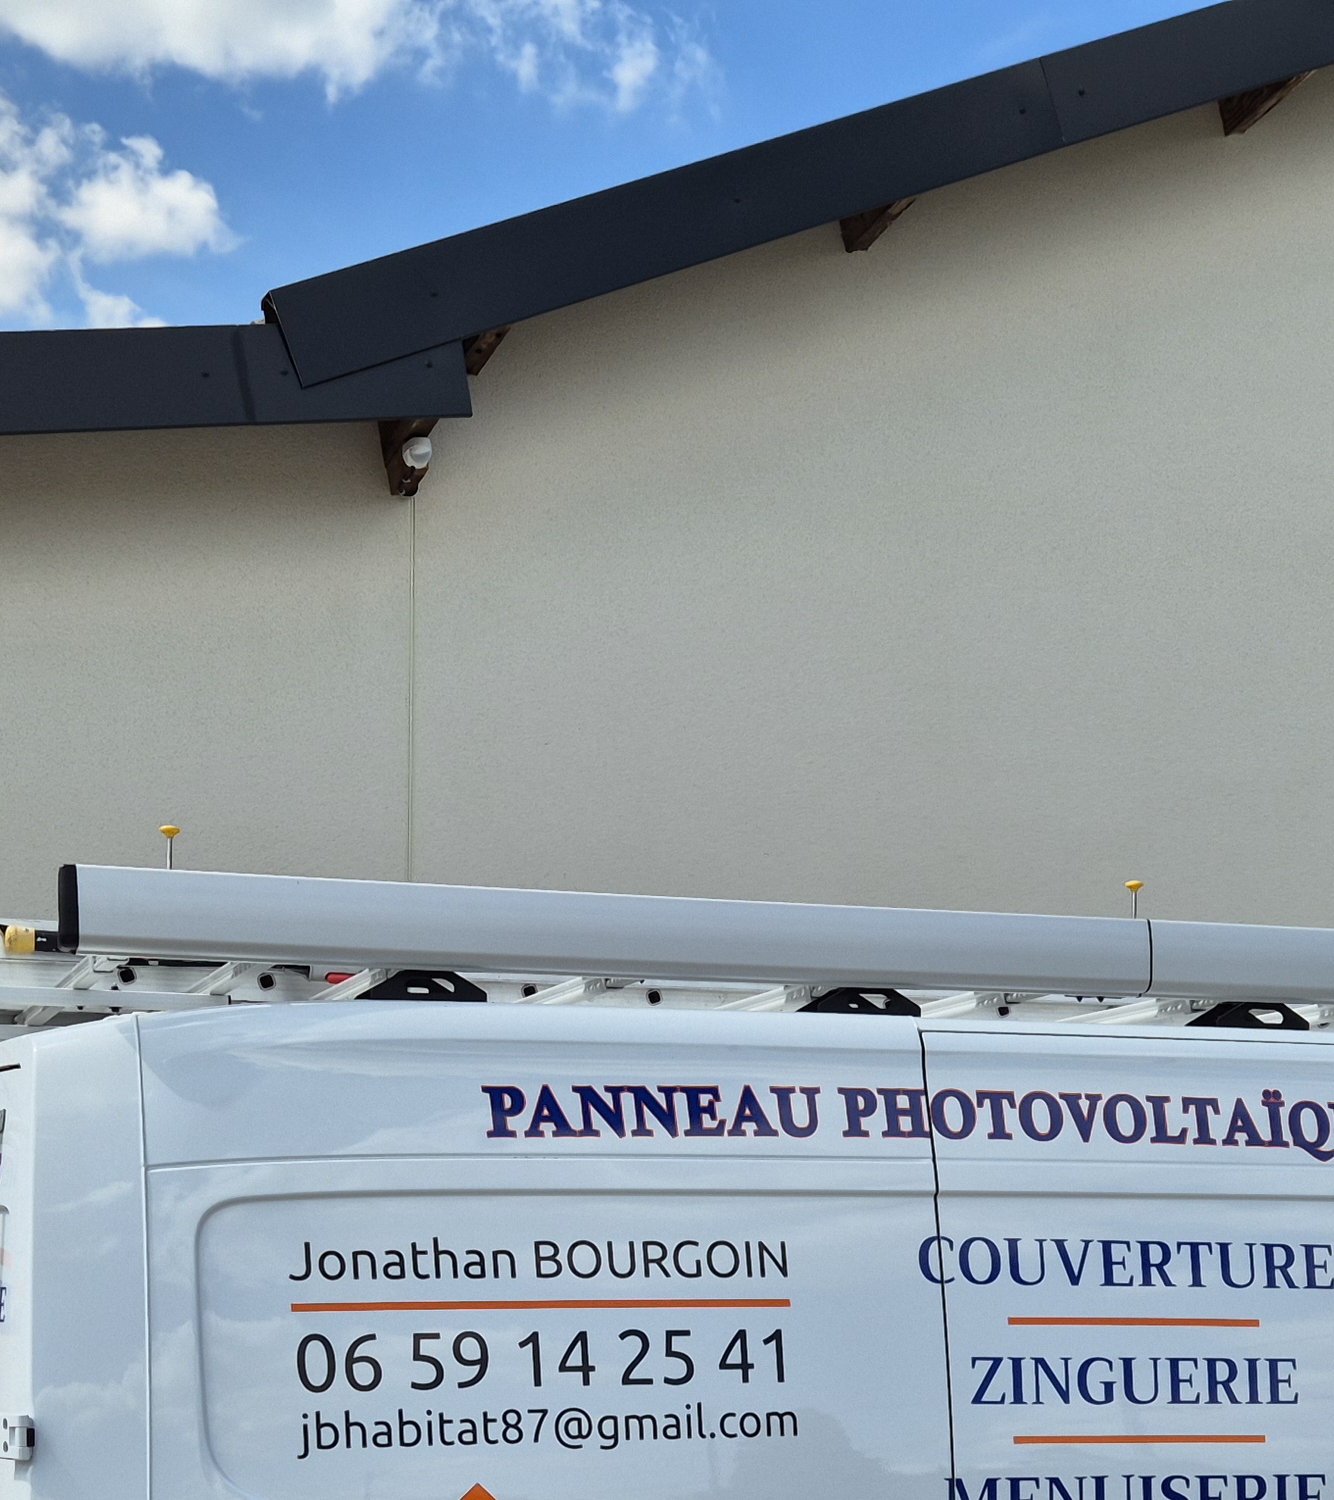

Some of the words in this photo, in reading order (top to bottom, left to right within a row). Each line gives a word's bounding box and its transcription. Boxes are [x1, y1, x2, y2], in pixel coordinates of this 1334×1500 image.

[479, 1083, 822, 1140] PANNEAU
[287, 1235, 518, 1282] Jonathan
[533, 1239, 789, 1280] BOURGOIN
[295, 1332, 384, 1394] 06
[409, 1330, 490, 1391] 59
[517, 1329, 597, 1389] 14
[617, 1327, 696, 1387] 25
[717, 1327, 786, 1385] 41
[969, 1355, 1300, 1407] ZINGUERIE
[296, 1400, 799, 1460] jbhabitat87@gmail.com
